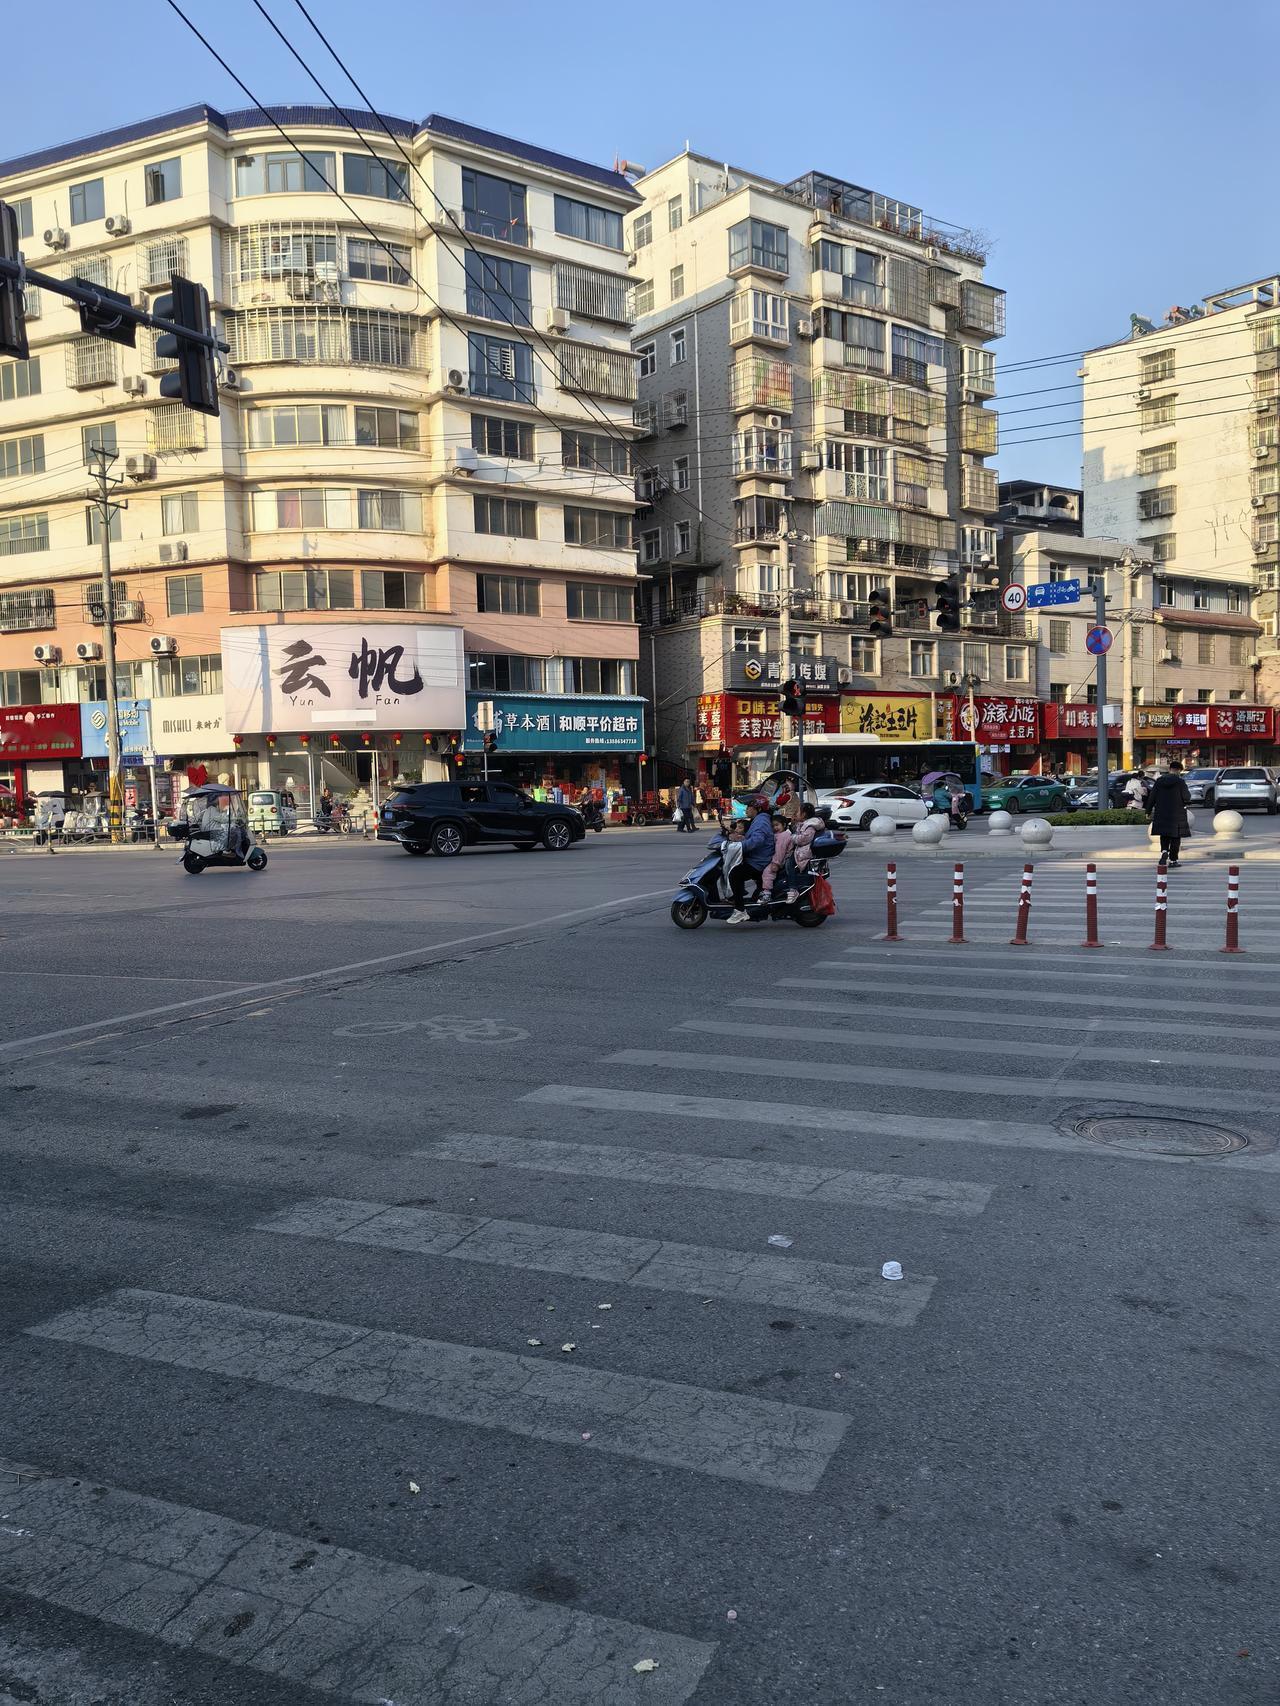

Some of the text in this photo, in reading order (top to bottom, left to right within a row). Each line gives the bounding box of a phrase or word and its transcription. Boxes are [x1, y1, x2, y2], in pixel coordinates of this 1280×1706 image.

[1008, 592, 1021, 604] 40
[272, 637, 424, 699] 云帆
[290, 695, 400, 706] Yun Fan
[504, 713, 550, 732] 草本酒
[559, 715, 638, 732] 和顺平价超市
[982, 702, 1035, 724] 涂家小吃
